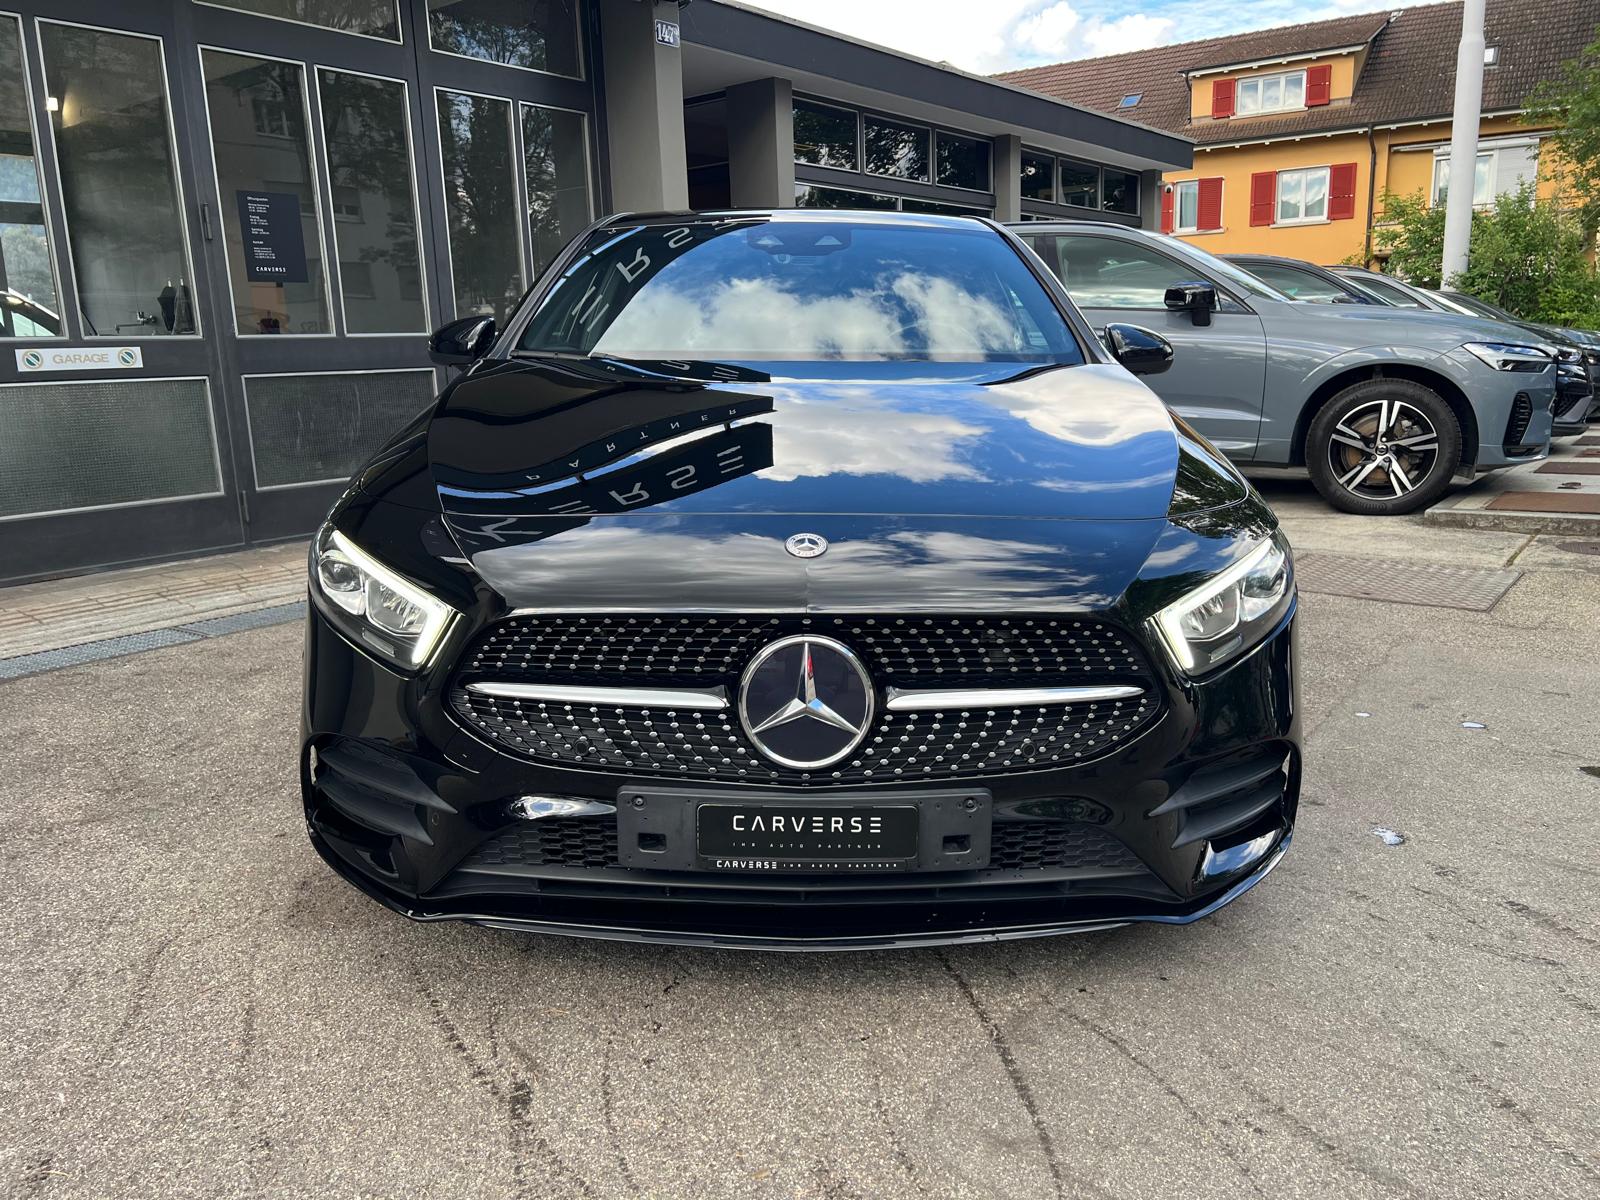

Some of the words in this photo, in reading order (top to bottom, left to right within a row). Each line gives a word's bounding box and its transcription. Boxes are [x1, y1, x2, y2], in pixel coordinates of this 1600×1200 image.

[52, 353, 109, 364] GARAGE
[732, 815, 881, 833] CARVERSE
[716, 860, 777, 869] CARVERSE
